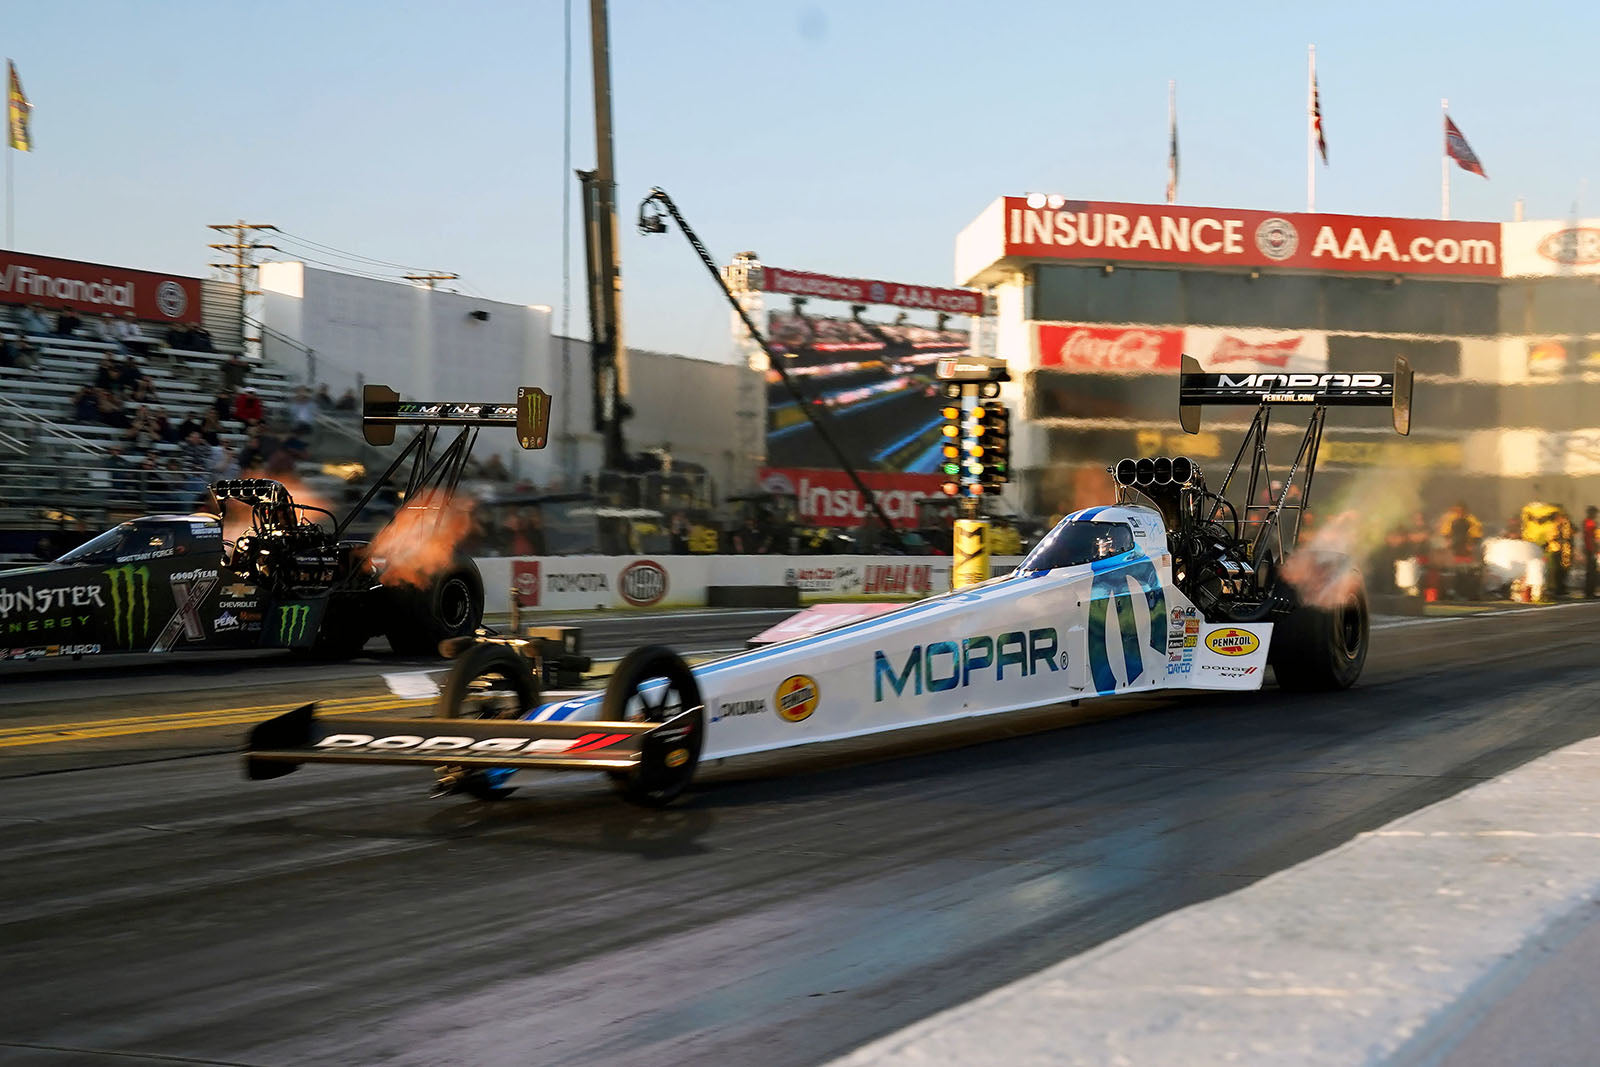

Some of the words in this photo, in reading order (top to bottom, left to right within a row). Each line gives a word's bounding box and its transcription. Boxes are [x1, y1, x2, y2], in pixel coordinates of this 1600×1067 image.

[1010, 208, 1245, 254] INSURANCE
[1312, 225, 1497, 265] AAA.com
[0, 264, 135, 308] /Financial
[892, 285, 978, 311] AAA.com
[1216, 374, 1385, 395] MOPAR
[170, 568, 218, 581] GOODYEAR
[546, 573, 609, 592] TOYOTA
[219, 600, 258, 608] CHEVROLET
[214, 616, 239, 630] PEAK
[1212, 636, 1252, 647] PENNZOIL
[874, 627, 1058, 702] MOPAR
[314, 733, 583, 755] DODGE
